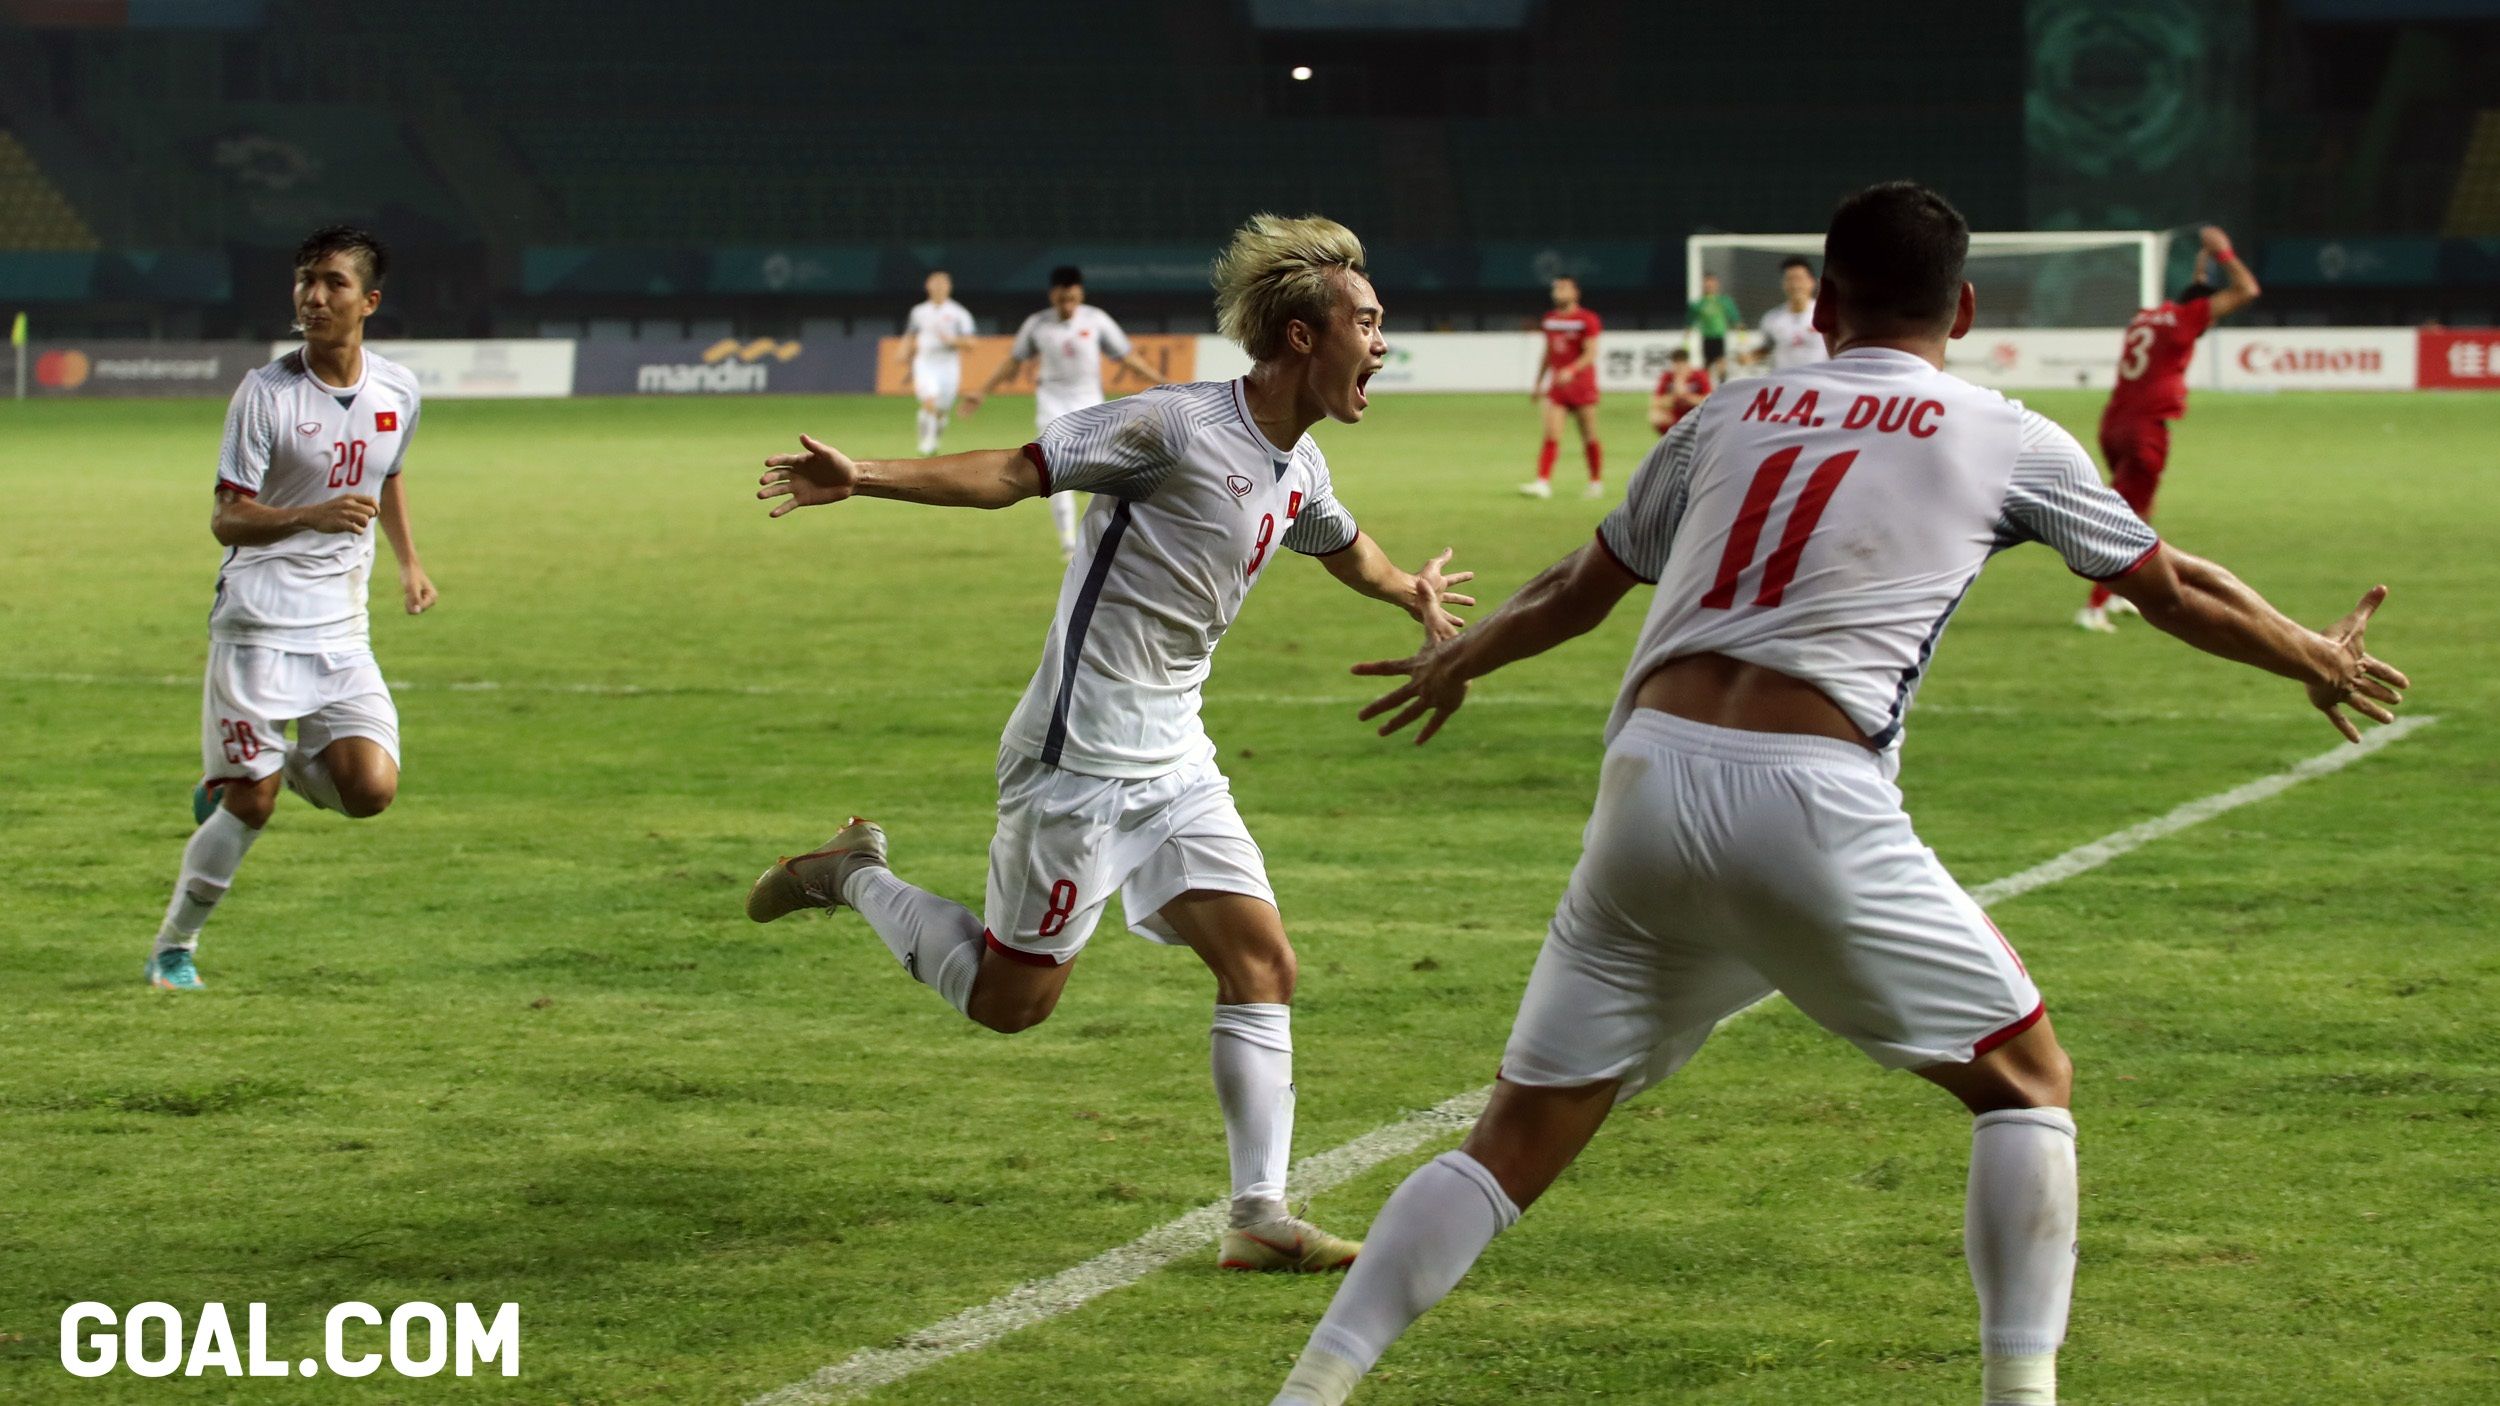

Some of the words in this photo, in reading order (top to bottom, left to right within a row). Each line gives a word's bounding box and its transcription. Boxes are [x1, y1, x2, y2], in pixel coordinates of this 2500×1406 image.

[638, 357, 767, 392] mandiri
[2120, 326, 2154, 379] 3
[2238, 341, 2382, 373] Canon
[1741, 386, 1825, 427] N.A.
[1841, 394, 1945, 438] DUC
[327, 440, 367, 488] 20
[1247, 513, 1275, 576] 8
[1700, 445, 1860, 609] 11
[221, 718, 260, 764] 20
[1039, 879, 1077, 937] 8
